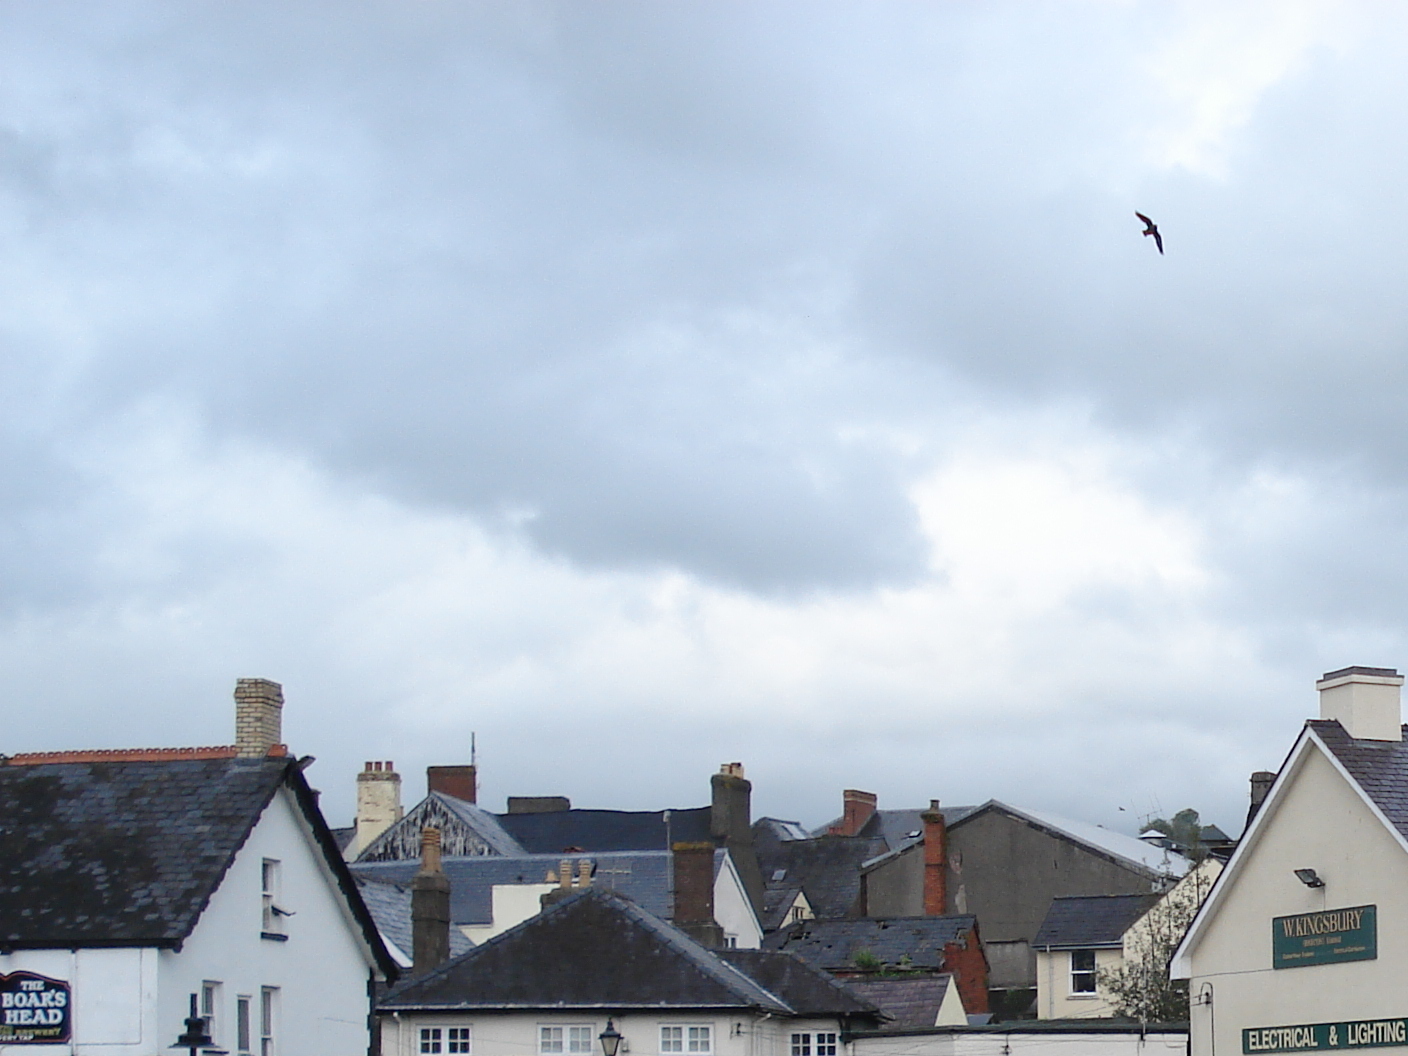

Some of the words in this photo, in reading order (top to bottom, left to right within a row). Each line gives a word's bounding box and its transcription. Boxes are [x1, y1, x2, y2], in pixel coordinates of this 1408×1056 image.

[21, 981, 45, 990] THE
[1, 989, 67, 1008] BOAR'S
[5, 1008, 63, 1025] HEAD
[1249, 1027, 1318, 1050] ELECTRICAL
[1328, 1025, 1339, 1046] &
[1348, 1021, 1406, 1045] LIGHTING
